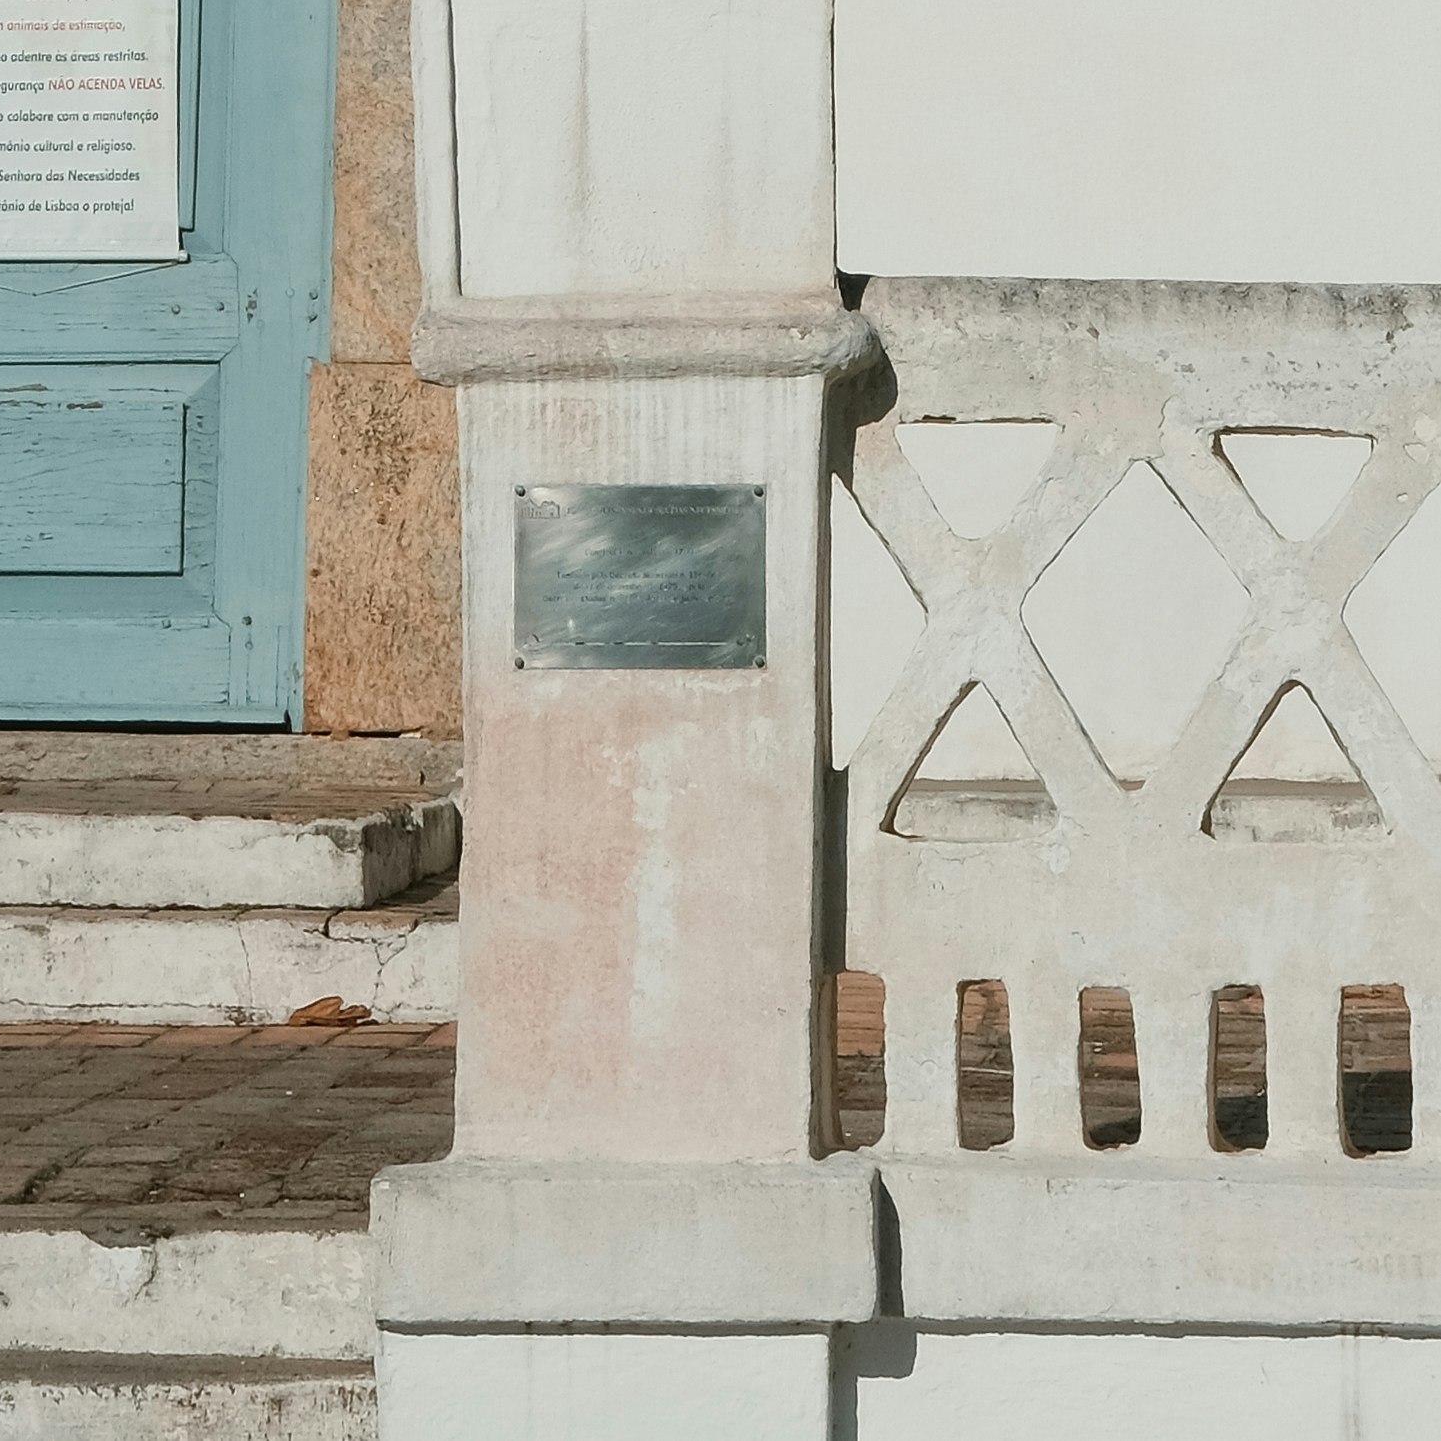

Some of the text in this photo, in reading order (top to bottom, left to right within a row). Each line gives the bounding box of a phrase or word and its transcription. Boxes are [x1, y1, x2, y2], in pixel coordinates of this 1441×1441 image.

[7, 19, 48, 30] animais
[52, 19, 65, 30] de
[69, 19, 125, 33] estimação,
[11, 50, 52, 62] adentre
[71, 50, 99, 61] áreas
[104, 49, 148, 61] restritas.
[48, 75, 74, 90] NÃO
[79, 78, 126, 90] ACENDA
[129, 78, 165, 90] VELAS.
[8, 109, 53, 121] colabore
[57, 113, 79, 121] com
[83, 113, 89, 121] a
[93, 109, 158, 124] manutenção
[34, 139, 73, 151] cultural
[77, 143, 83, 151] e
[87, 139, 135, 154] religioso.
[46, 170, 64, 181] das
[68, 169, 140, 181] Necessidades
[28, 200, 41, 211] de
[46, 199, 79, 211] Lisboa
[83, 202, 89, 211] o
[93, 199, 134, 214] proteja!
